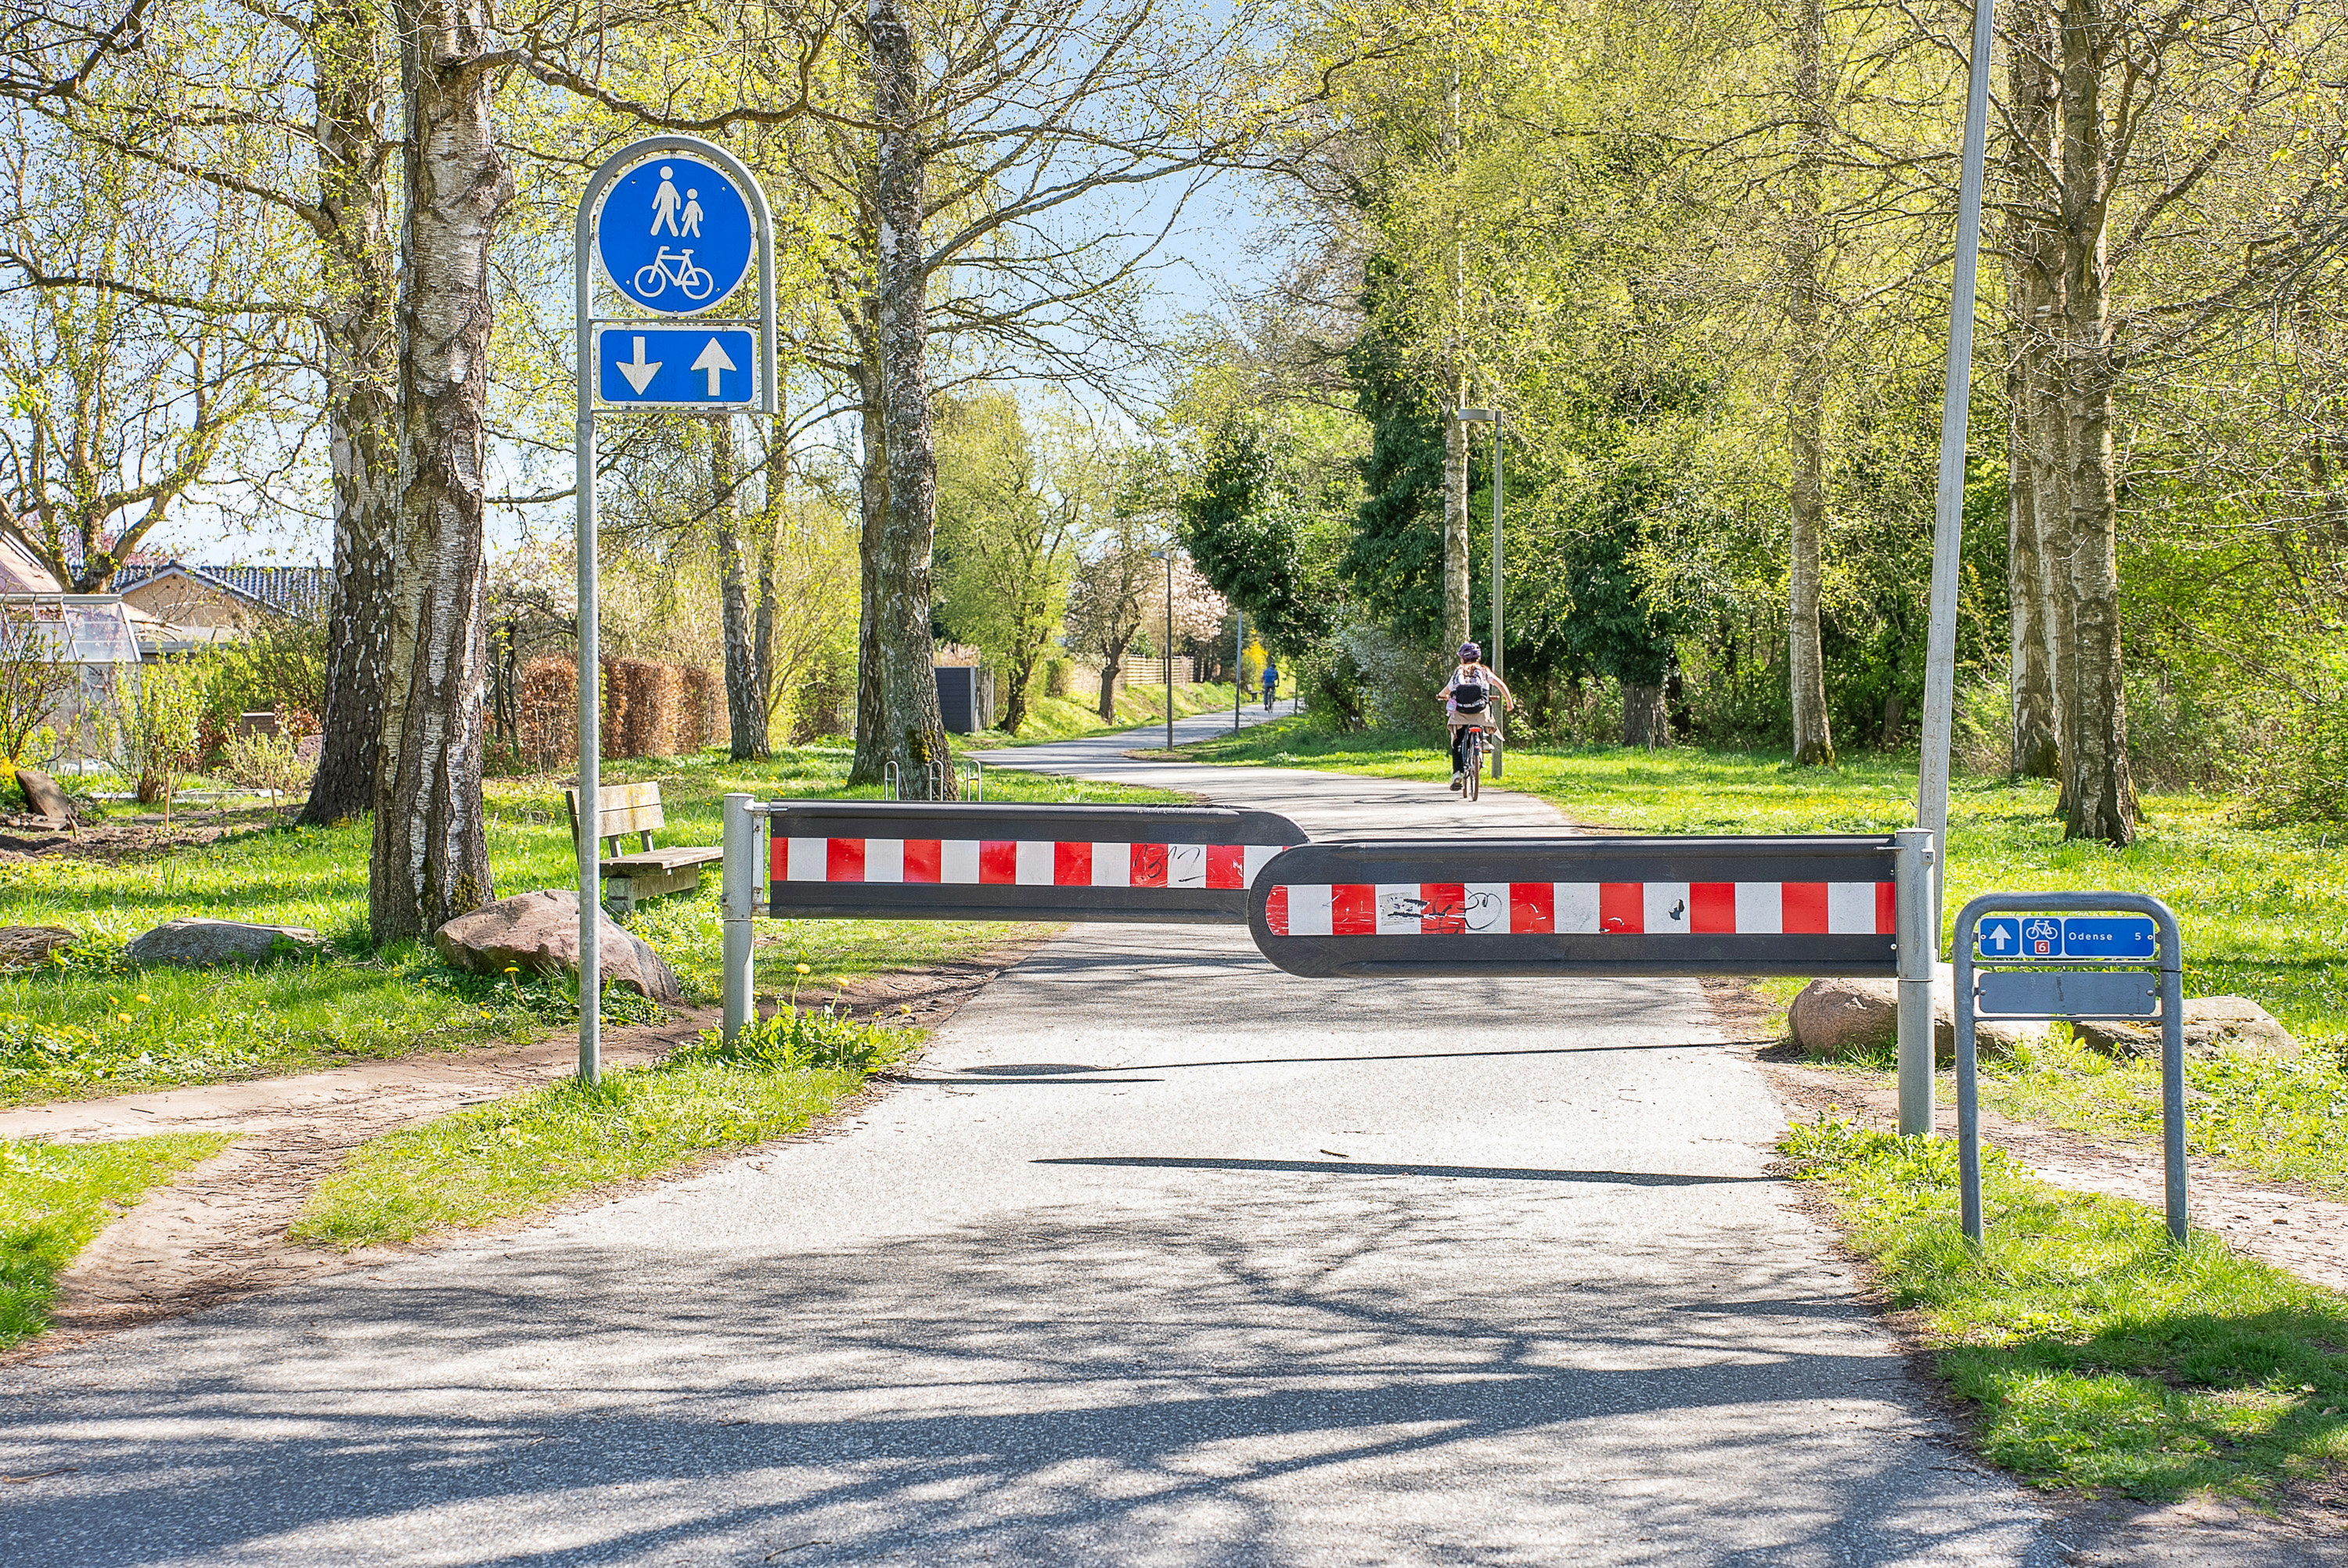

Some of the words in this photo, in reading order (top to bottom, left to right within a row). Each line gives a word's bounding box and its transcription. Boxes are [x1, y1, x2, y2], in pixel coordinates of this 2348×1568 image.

[2069, 932, 2113, 940] Odense
[2134, 932, 2141, 940] 5
[2038, 943, 2046, 951] 6
